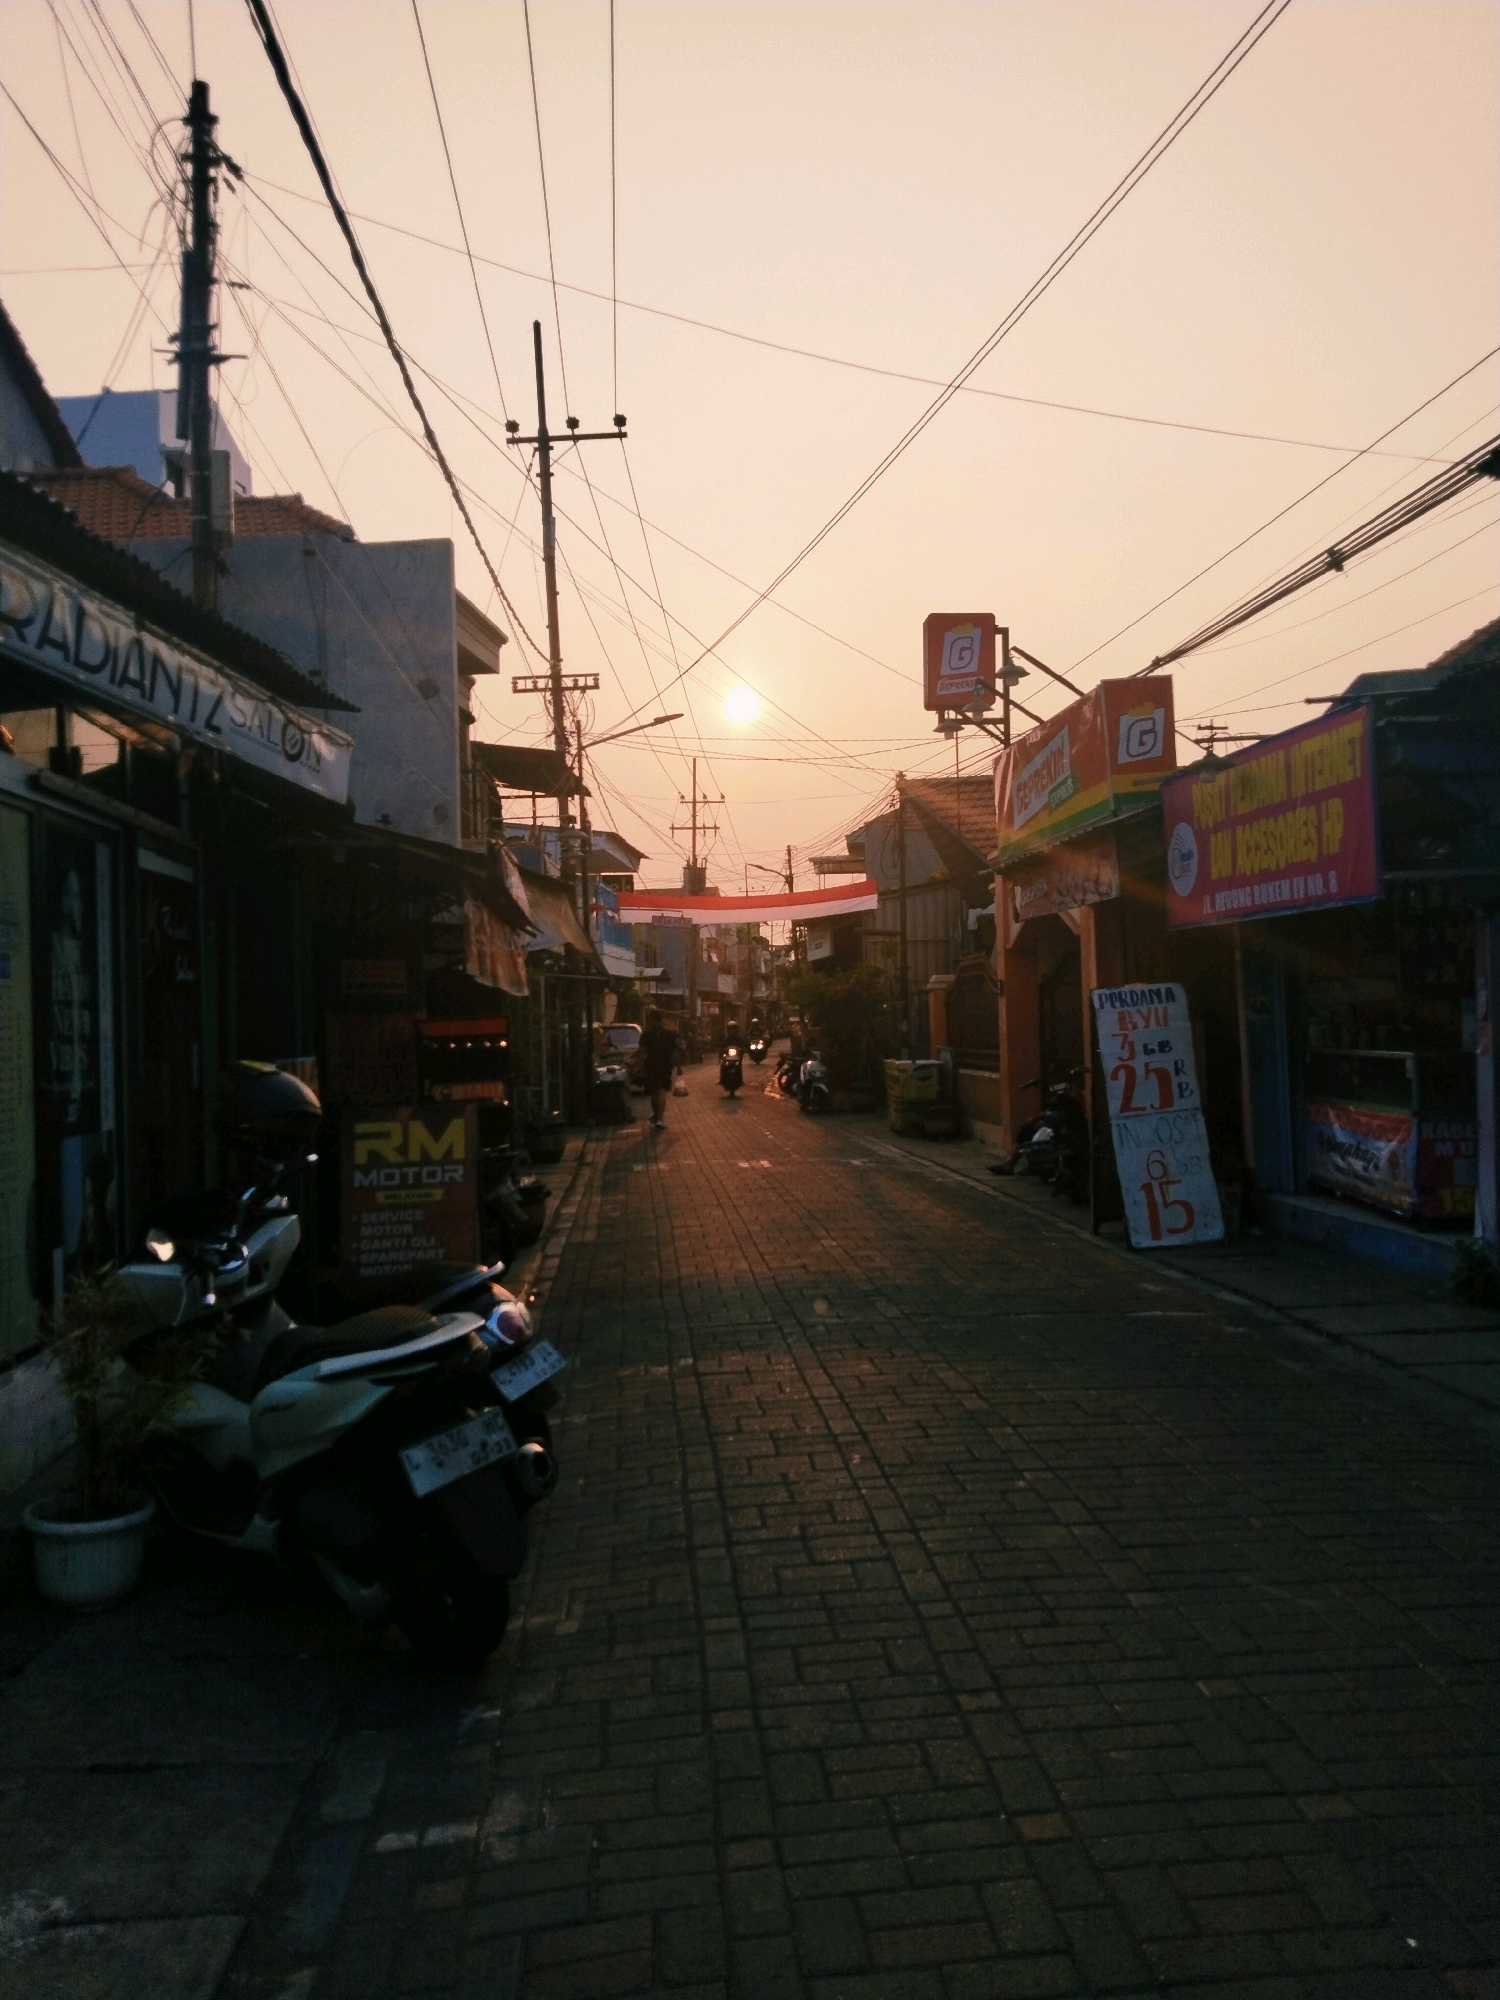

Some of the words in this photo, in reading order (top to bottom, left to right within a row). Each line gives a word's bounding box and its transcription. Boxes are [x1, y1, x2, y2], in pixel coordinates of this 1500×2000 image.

[1290, 718, 1363, 799] INTERNET
[1321, 797, 1344, 857] HP
[1117, 1005, 1169, 1032] BYU
[1110, 1060, 1175, 1113] 25
[354, 1117, 466, 1165] RM
[353, 1164, 465, 1188] MOTOR
[360, 1209, 424, 1224] SERVICE
[1140, 1179, 1195, 1241] 15
[360, 1224, 413, 1237] MOTOR
[360, 1237, 406, 1251] GANTI
[410, 1235, 436, 1248] OLI
[360, 1248, 446, 1264] SPAREPART
